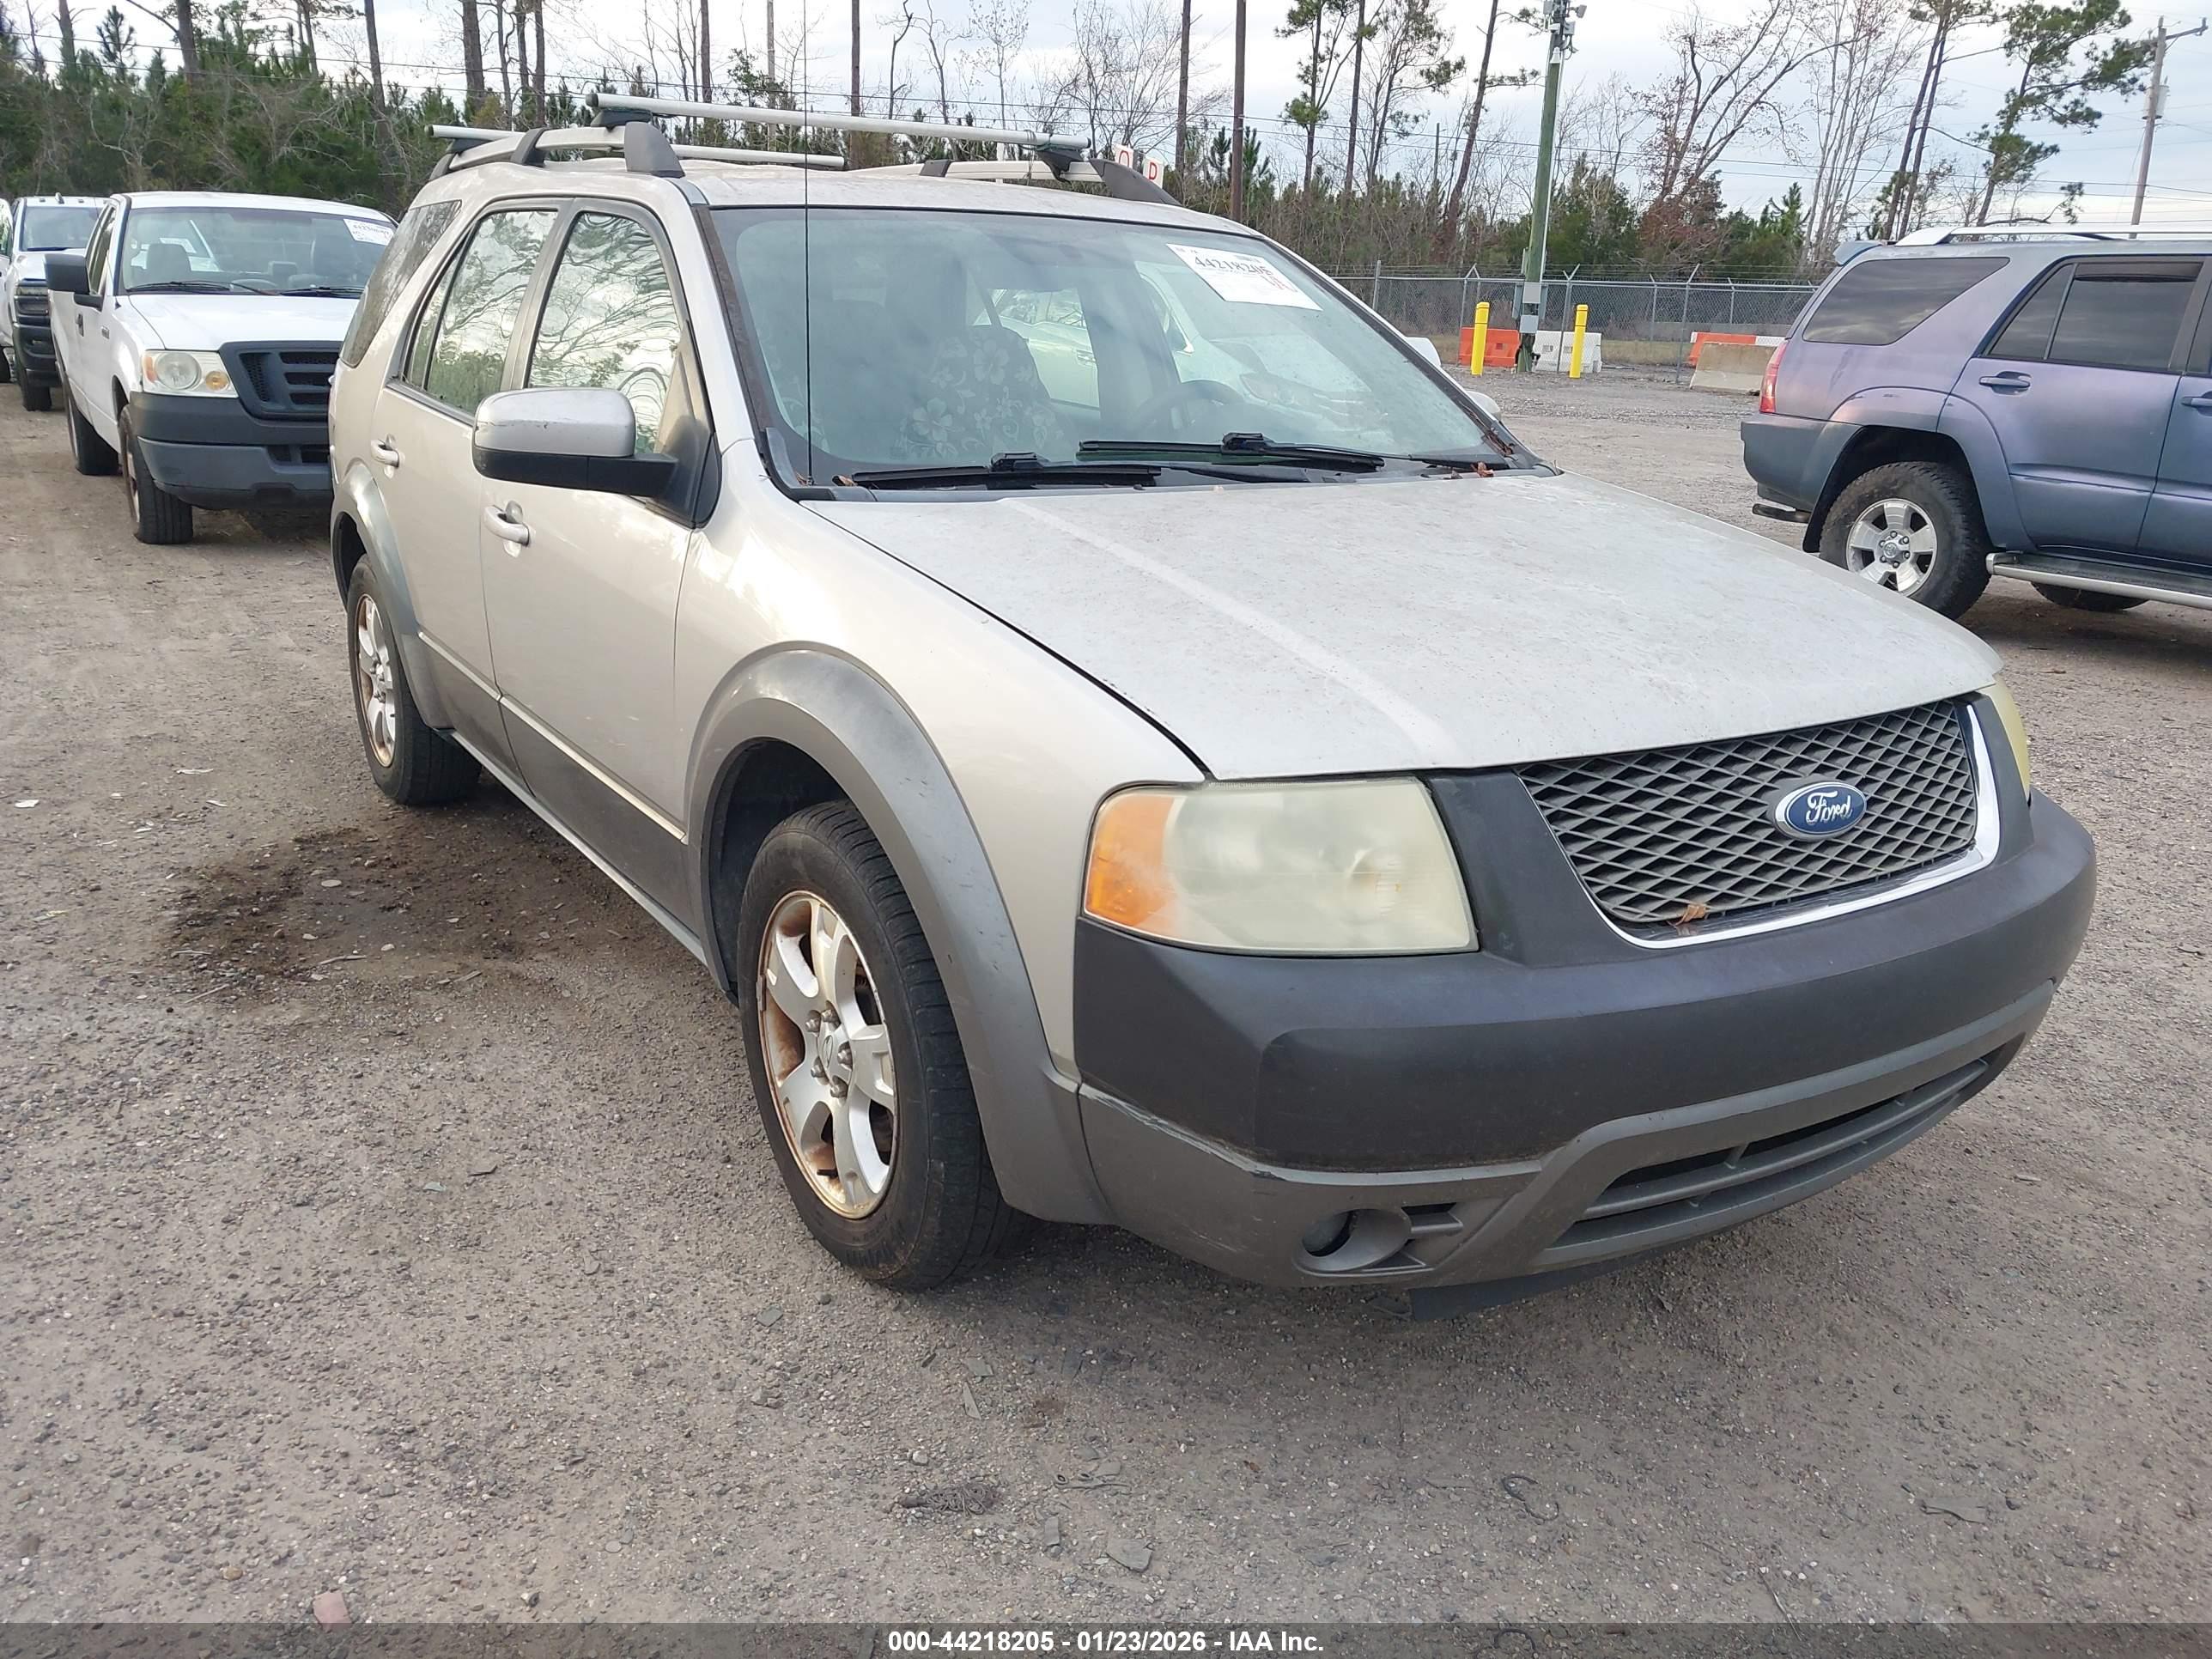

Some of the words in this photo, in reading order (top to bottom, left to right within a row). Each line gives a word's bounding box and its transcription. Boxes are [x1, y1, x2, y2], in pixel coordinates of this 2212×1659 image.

[1148, 161, 1158, 180] D
[1194, 256, 1274, 276] 44218205
[1805, 790, 1853, 825] Ford
